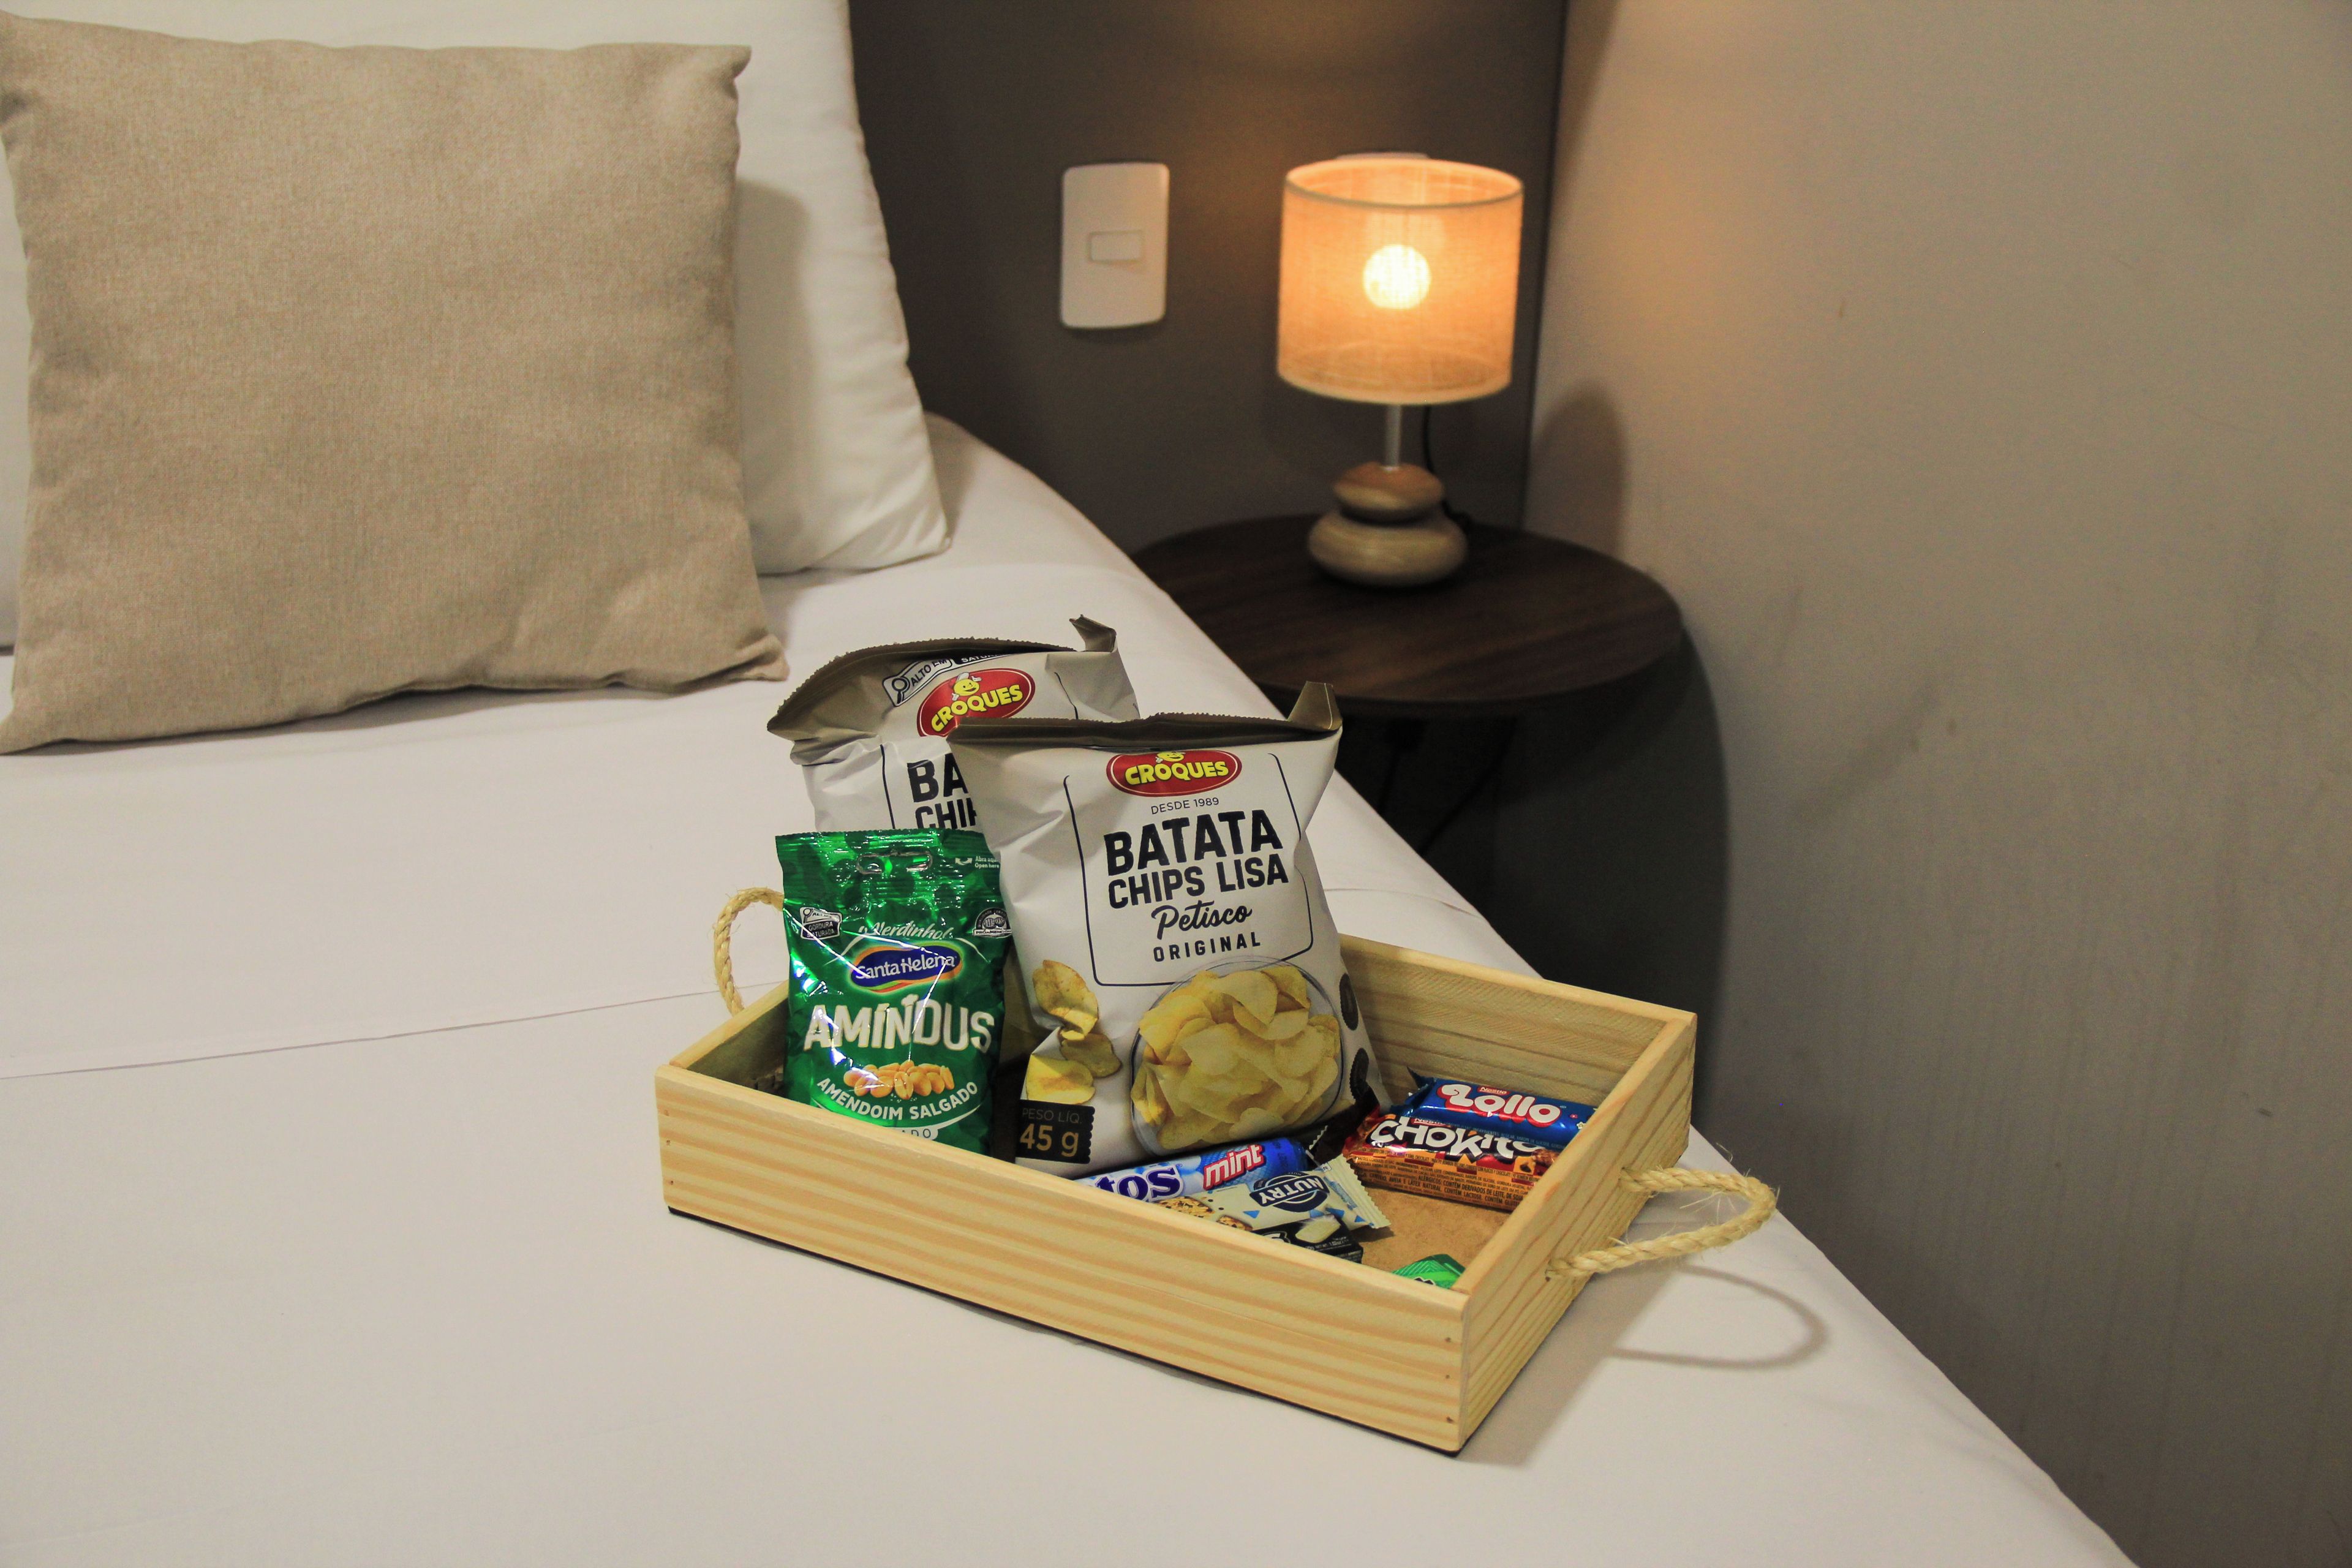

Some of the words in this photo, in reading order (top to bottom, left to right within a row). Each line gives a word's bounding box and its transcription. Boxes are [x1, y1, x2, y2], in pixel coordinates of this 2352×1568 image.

[911, 665, 932, 687] ALTO
[930, 683, 1023, 733] CROQUES
[1125, 761, 1229, 785] CROQUES
[1151, 799, 1190, 815] DESDE
[1193, 797, 1219, 808] 1989
[1104, 809, 1283, 876] BATATA
[1108, 865, 1205, 908] CHIPS
[1216, 853, 1289, 892] LISA
[808, 921, 833, 931] GORDURA
[1151, 900, 1253, 940] Petisco
[1153, 932, 1261, 962] ORIGINAL
[816, 1077, 903, 1121] AMENDOIM
[910, 1081, 979, 1120] SALGADO
[1022, 1107, 1054, 1121] PESO
[1058, 1110, 1082, 1124] LÍQ.
[1019, 1123, 1053, 1151] 45
[1061, 1131, 1079, 1157] g
[1205, 1144, 1265, 1189] mint
[1259, 1177, 1324, 1204] NUTRY
